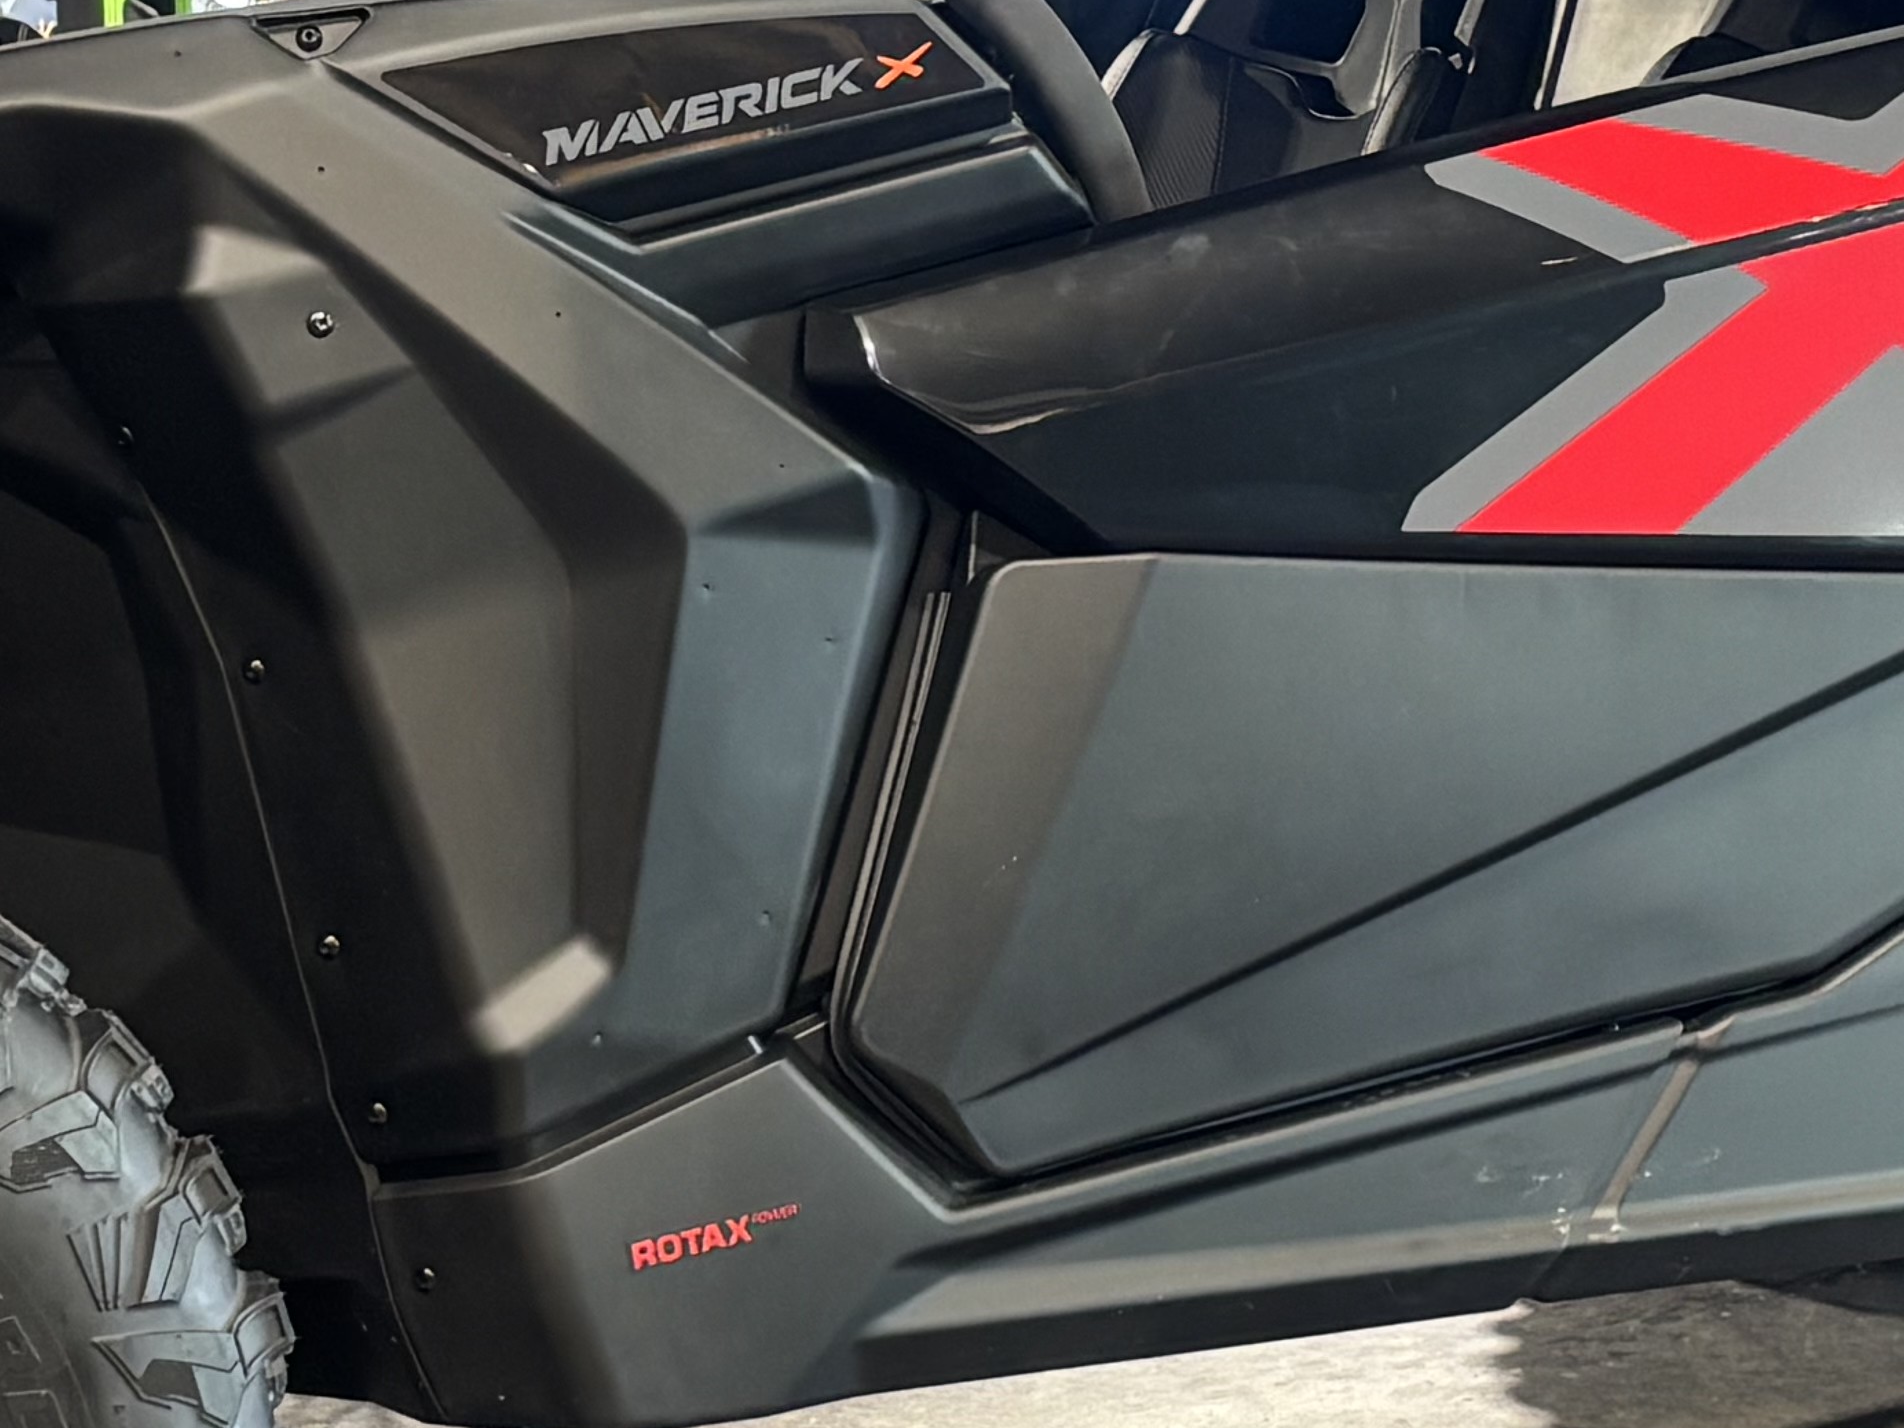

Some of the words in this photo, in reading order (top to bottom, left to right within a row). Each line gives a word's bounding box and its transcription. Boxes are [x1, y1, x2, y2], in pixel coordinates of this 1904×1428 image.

[542, 58, 864, 165] MAVERICK
[874, 41, 934, 90] X
[631, 1214, 753, 1271] ROTAX
